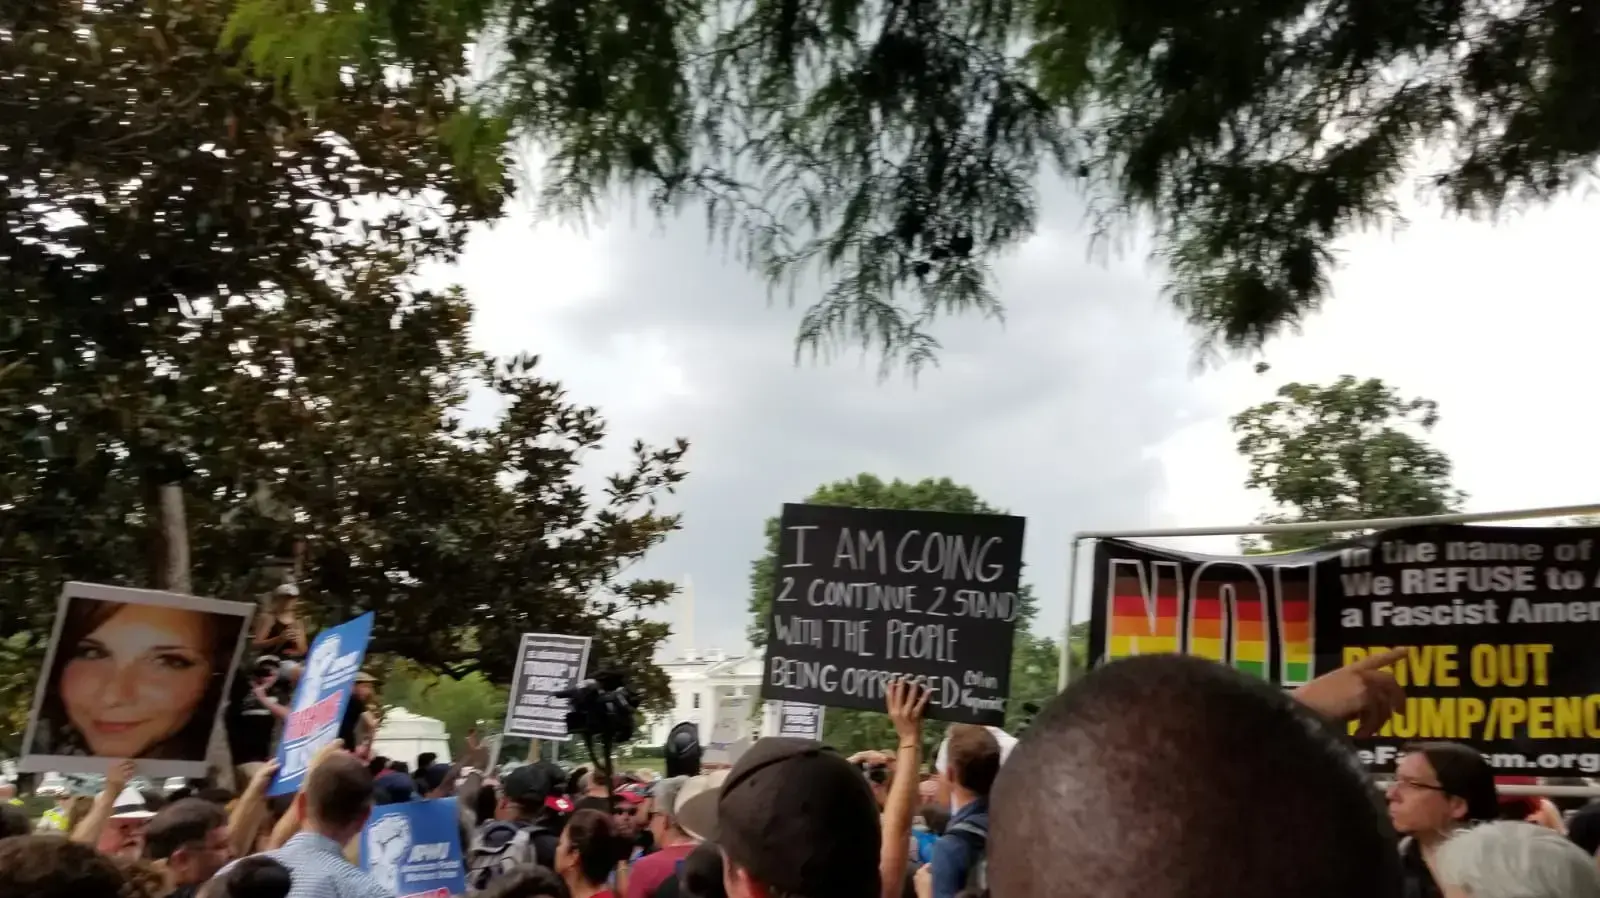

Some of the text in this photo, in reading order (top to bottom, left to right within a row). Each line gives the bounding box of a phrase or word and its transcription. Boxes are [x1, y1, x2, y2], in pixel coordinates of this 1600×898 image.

[782, 525, 1003, 582] I AM GOING
[1381, 539, 1438, 563] the
[1446, 541, 1544, 562] name
[1553, 539, 1593, 561] of
[776, 577, 1018, 623] 2 CONTINUE 2 STAND
[1340, 572, 1394, 596] We
[1401, 566, 1537, 595] REFUSE
[1544, 567, 1585, 590] to
[1341, 606, 1364, 628] a
[1371, 599, 1500, 627] Fascist
[774, 615, 959, 663] WITH THE PEOPLE
[771, 657, 839, 692] BEING
[1470, 643, 1554, 688] OUT
